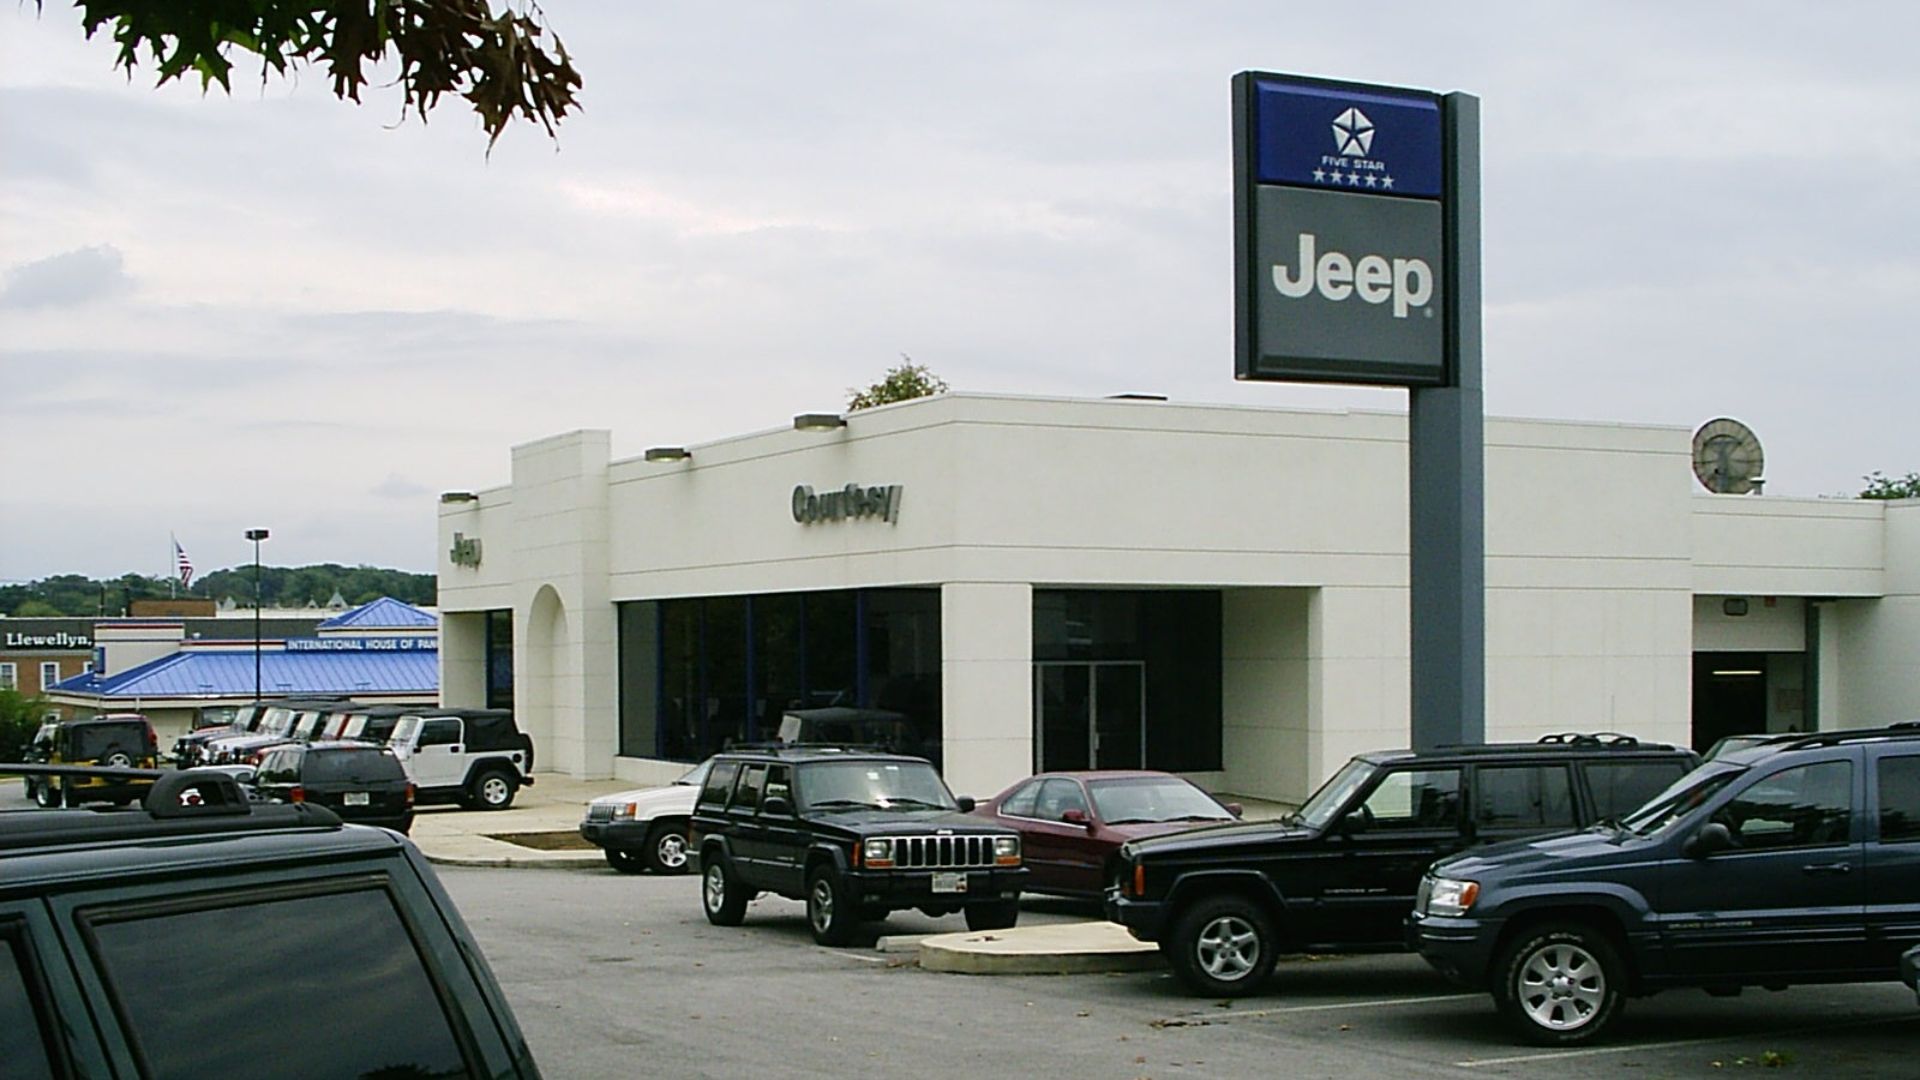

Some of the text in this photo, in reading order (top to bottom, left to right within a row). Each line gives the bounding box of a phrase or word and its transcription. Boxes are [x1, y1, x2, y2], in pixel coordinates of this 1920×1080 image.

[1321, 155, 1385, 171] FIVE STAR
[1272, 233, 1433, 318] Jeep
[287, 639, 364, 650] INTERNATIONAL
[365, 639, 397, 650] HOUSE
[400, 639, 413, 650] OF
